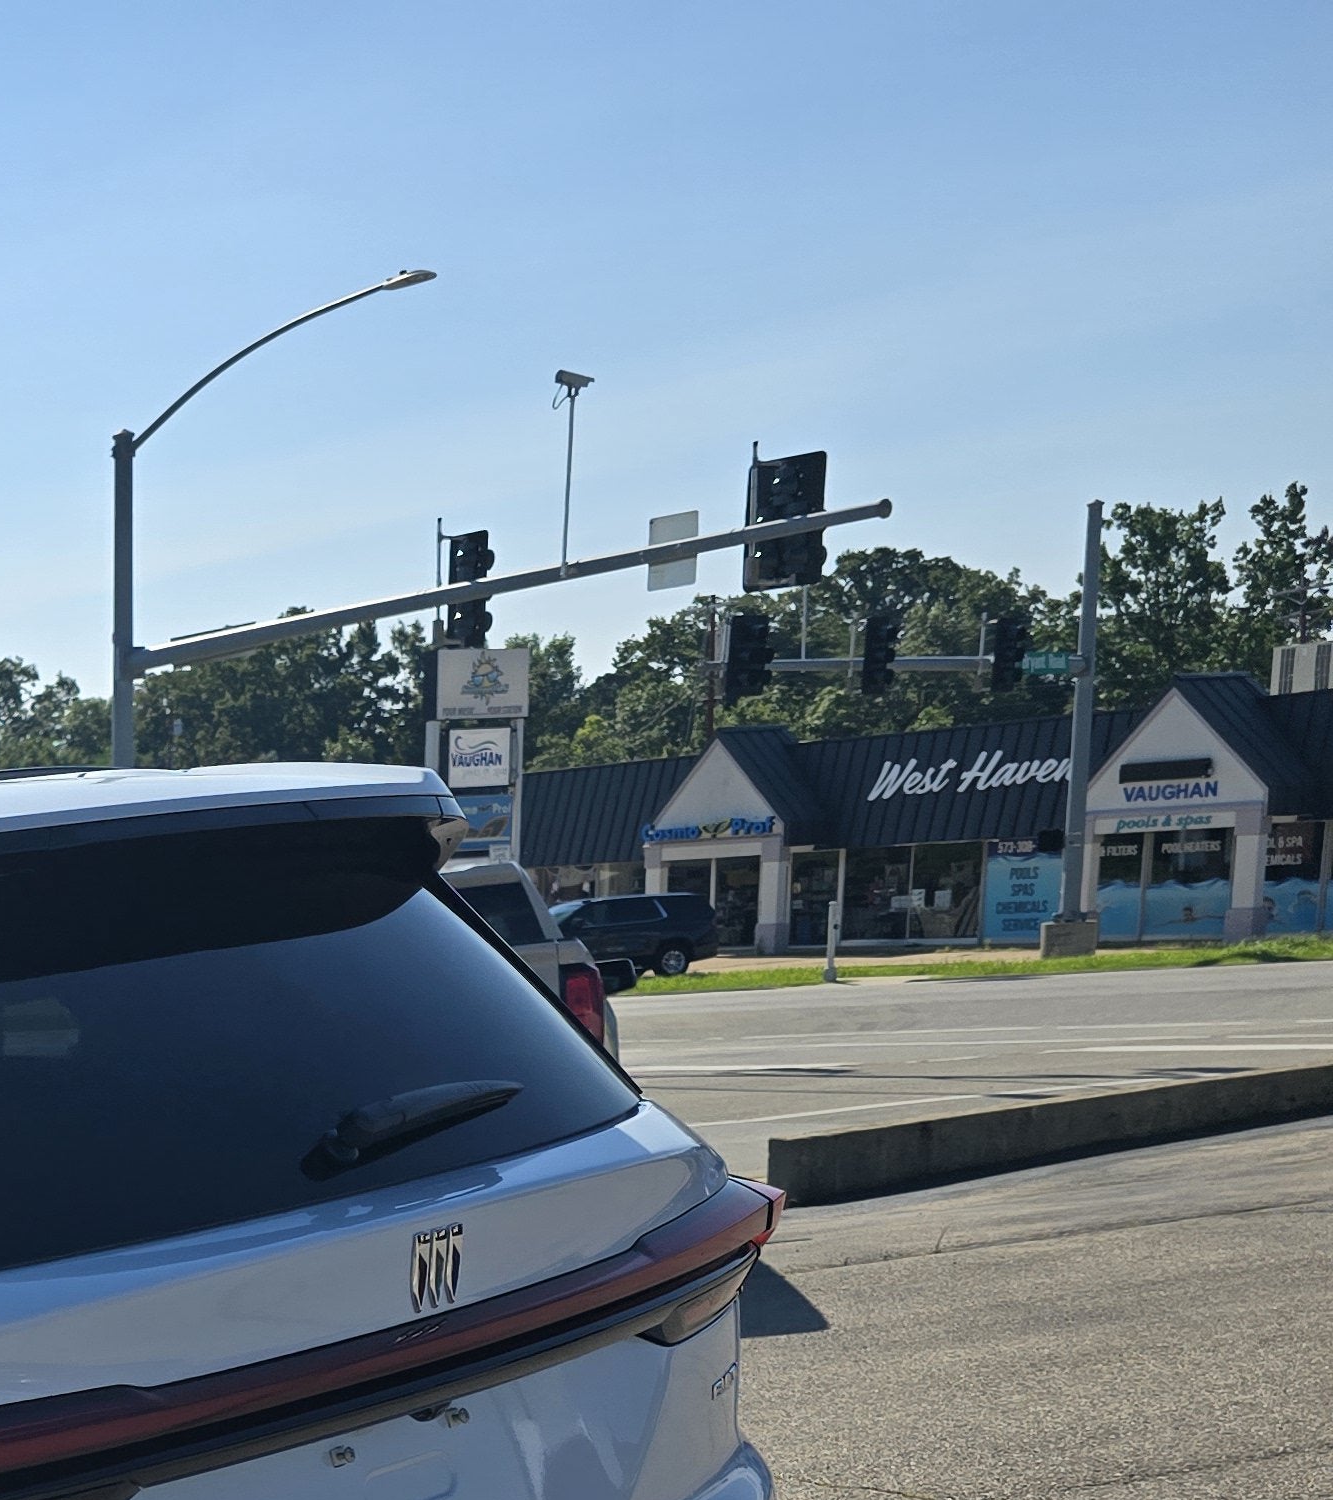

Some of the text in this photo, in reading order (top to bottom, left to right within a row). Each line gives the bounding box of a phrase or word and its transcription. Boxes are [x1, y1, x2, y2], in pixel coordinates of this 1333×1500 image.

[451, 751, 502, 767] VAUGHAN
[867, 750, 1072, 801] West Haven
[1123, 780, 1219, 802] VAUGHAN
[642, 816, 775, 841] Cosmo Prof
[1116, 813, 1213, 833] pools & spas
[1266, 854, 1302, 866] EMICALS
[1009, 867, 1039, 880] POOLS
[1011, 883, 1035, 896] SPAS
